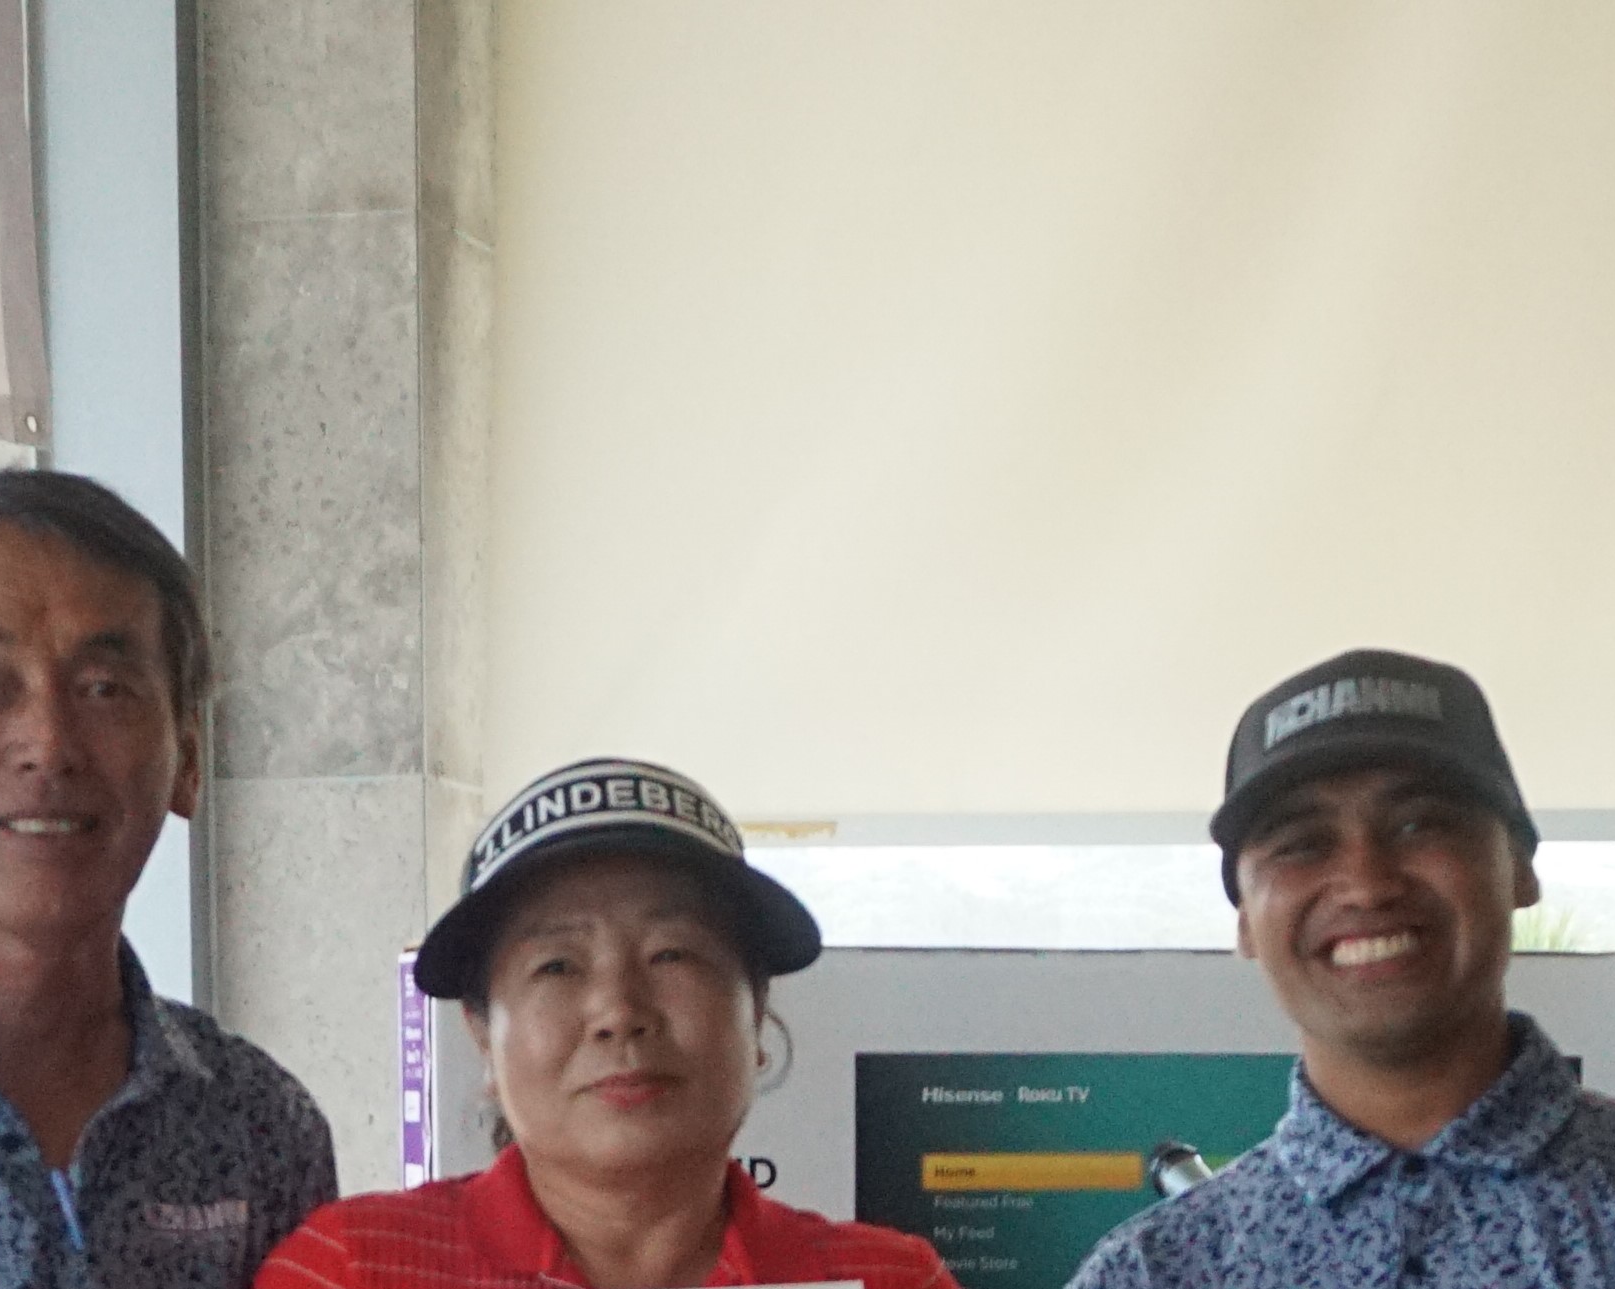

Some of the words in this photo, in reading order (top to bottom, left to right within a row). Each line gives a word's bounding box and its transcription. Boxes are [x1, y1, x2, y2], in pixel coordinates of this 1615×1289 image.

[922, 1086, 1004, 1104] Hisense
[1065, 1086, 1091, 1104] TV
[736, 1157, 777, 1189] D
[935, 1165, 977, 1178] Home
[933, 1226, 954, 1241] My
[958, 1225, 996, 1240] Feed
[979, 1255, 1019, 1271] Store
